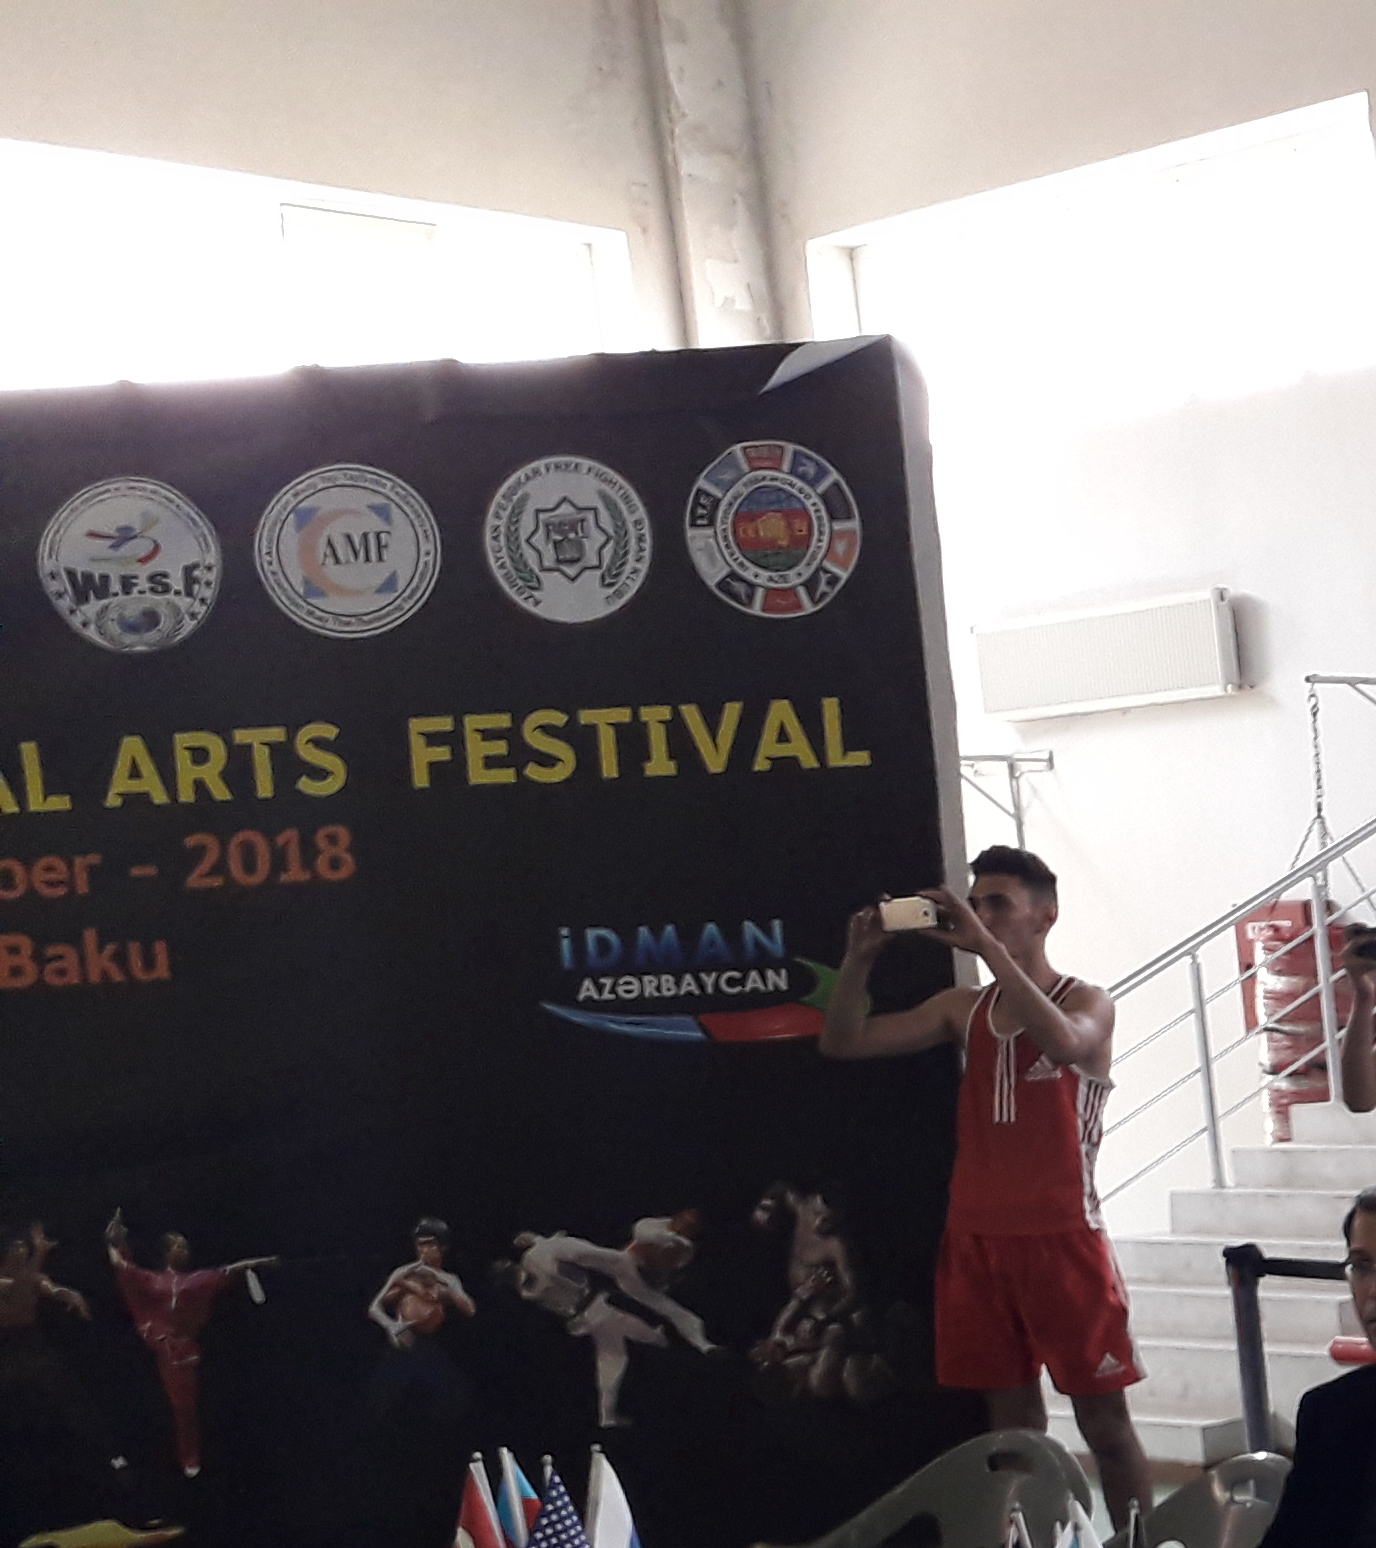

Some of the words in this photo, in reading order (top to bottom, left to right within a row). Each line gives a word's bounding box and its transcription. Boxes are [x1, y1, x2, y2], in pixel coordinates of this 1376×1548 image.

[321, 530, 391, 565] AMF
[103, 721, 349, 808] ARTS
[408, 697, 872, 788] FESTIVAL
[184, 824, 357, 888] 2018
[0, 926, 171, 988] Baku
[577, 967, 790, 1001] AZƏRBAYCAN
